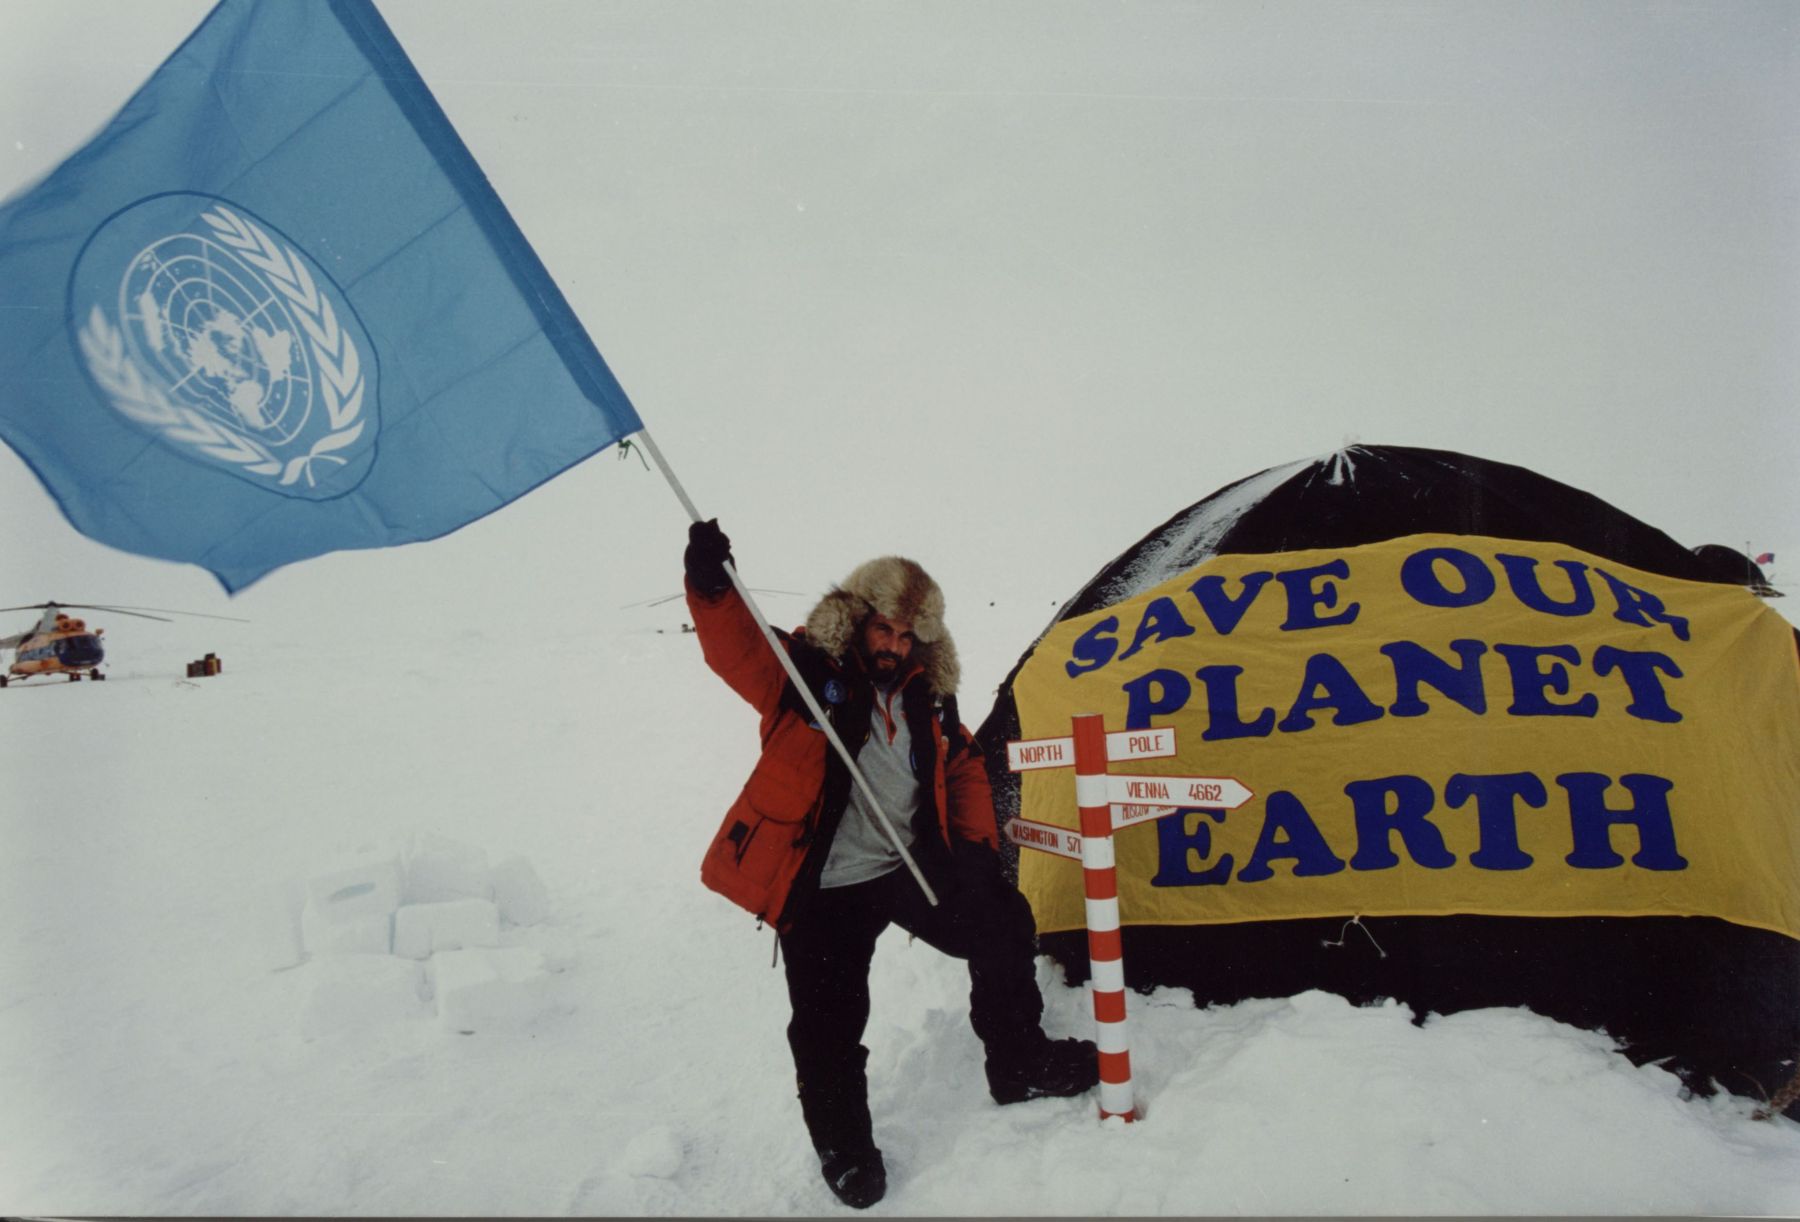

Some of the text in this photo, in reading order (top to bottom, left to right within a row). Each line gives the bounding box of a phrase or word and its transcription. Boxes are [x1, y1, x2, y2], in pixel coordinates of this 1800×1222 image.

[1066, 547, 1690, 677] SAVE OUR
[1122, 639, 1684, 741] PLANET
[1019, 735, 1163, 763] NORTH POLE
[1126, 781, 1222, 802] VIENNA 4662
[1012, 823, 1059, 849] WASHINGTON
[1151, 772, 1689, 887] EARTH
